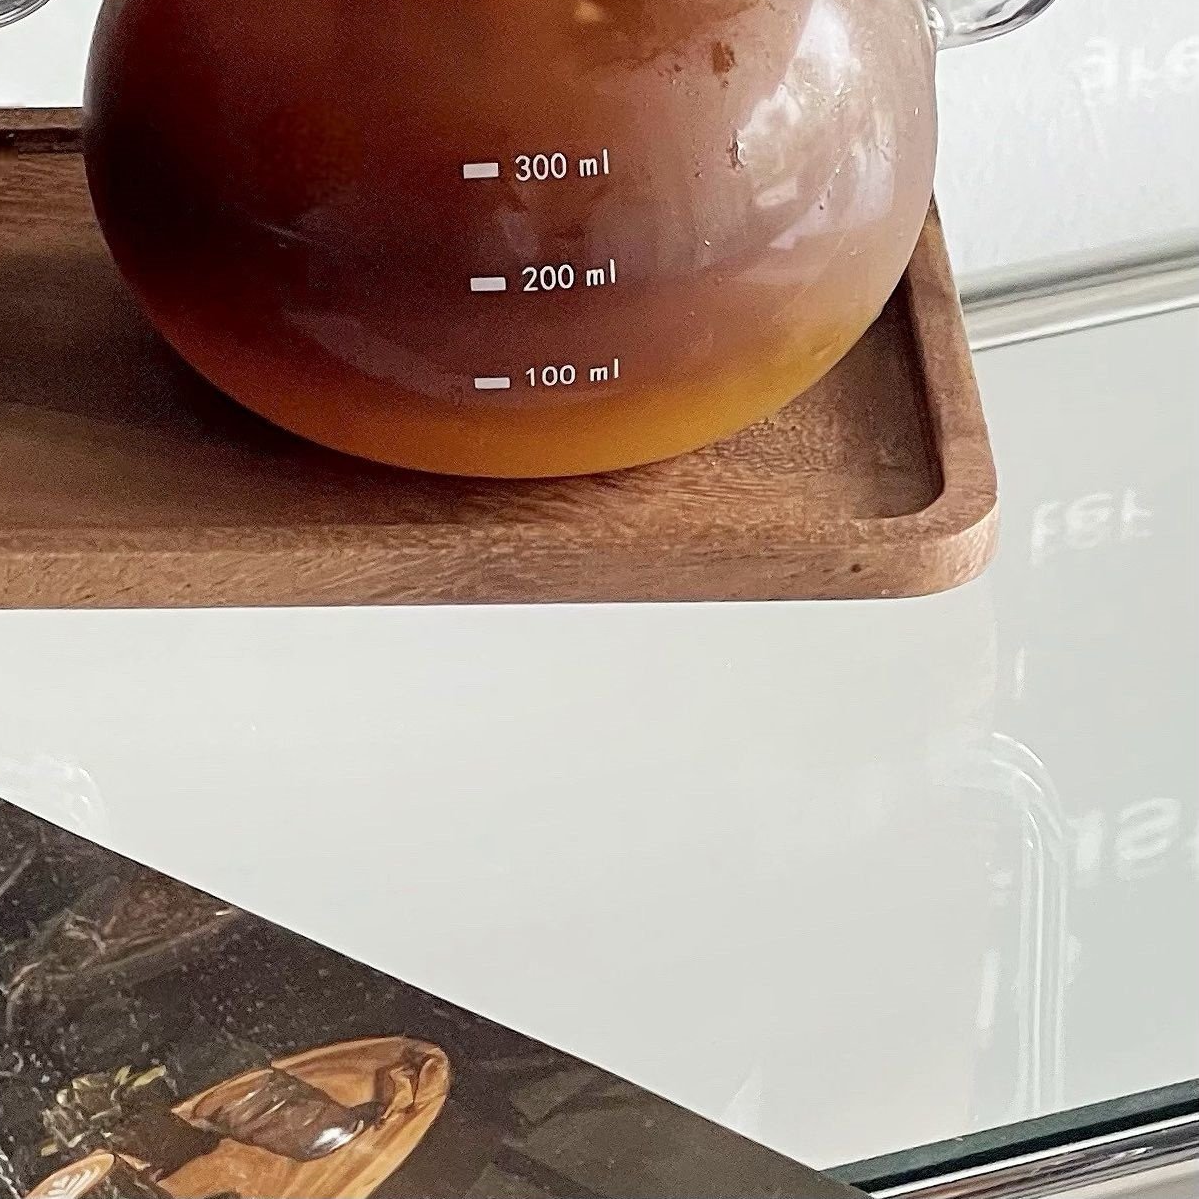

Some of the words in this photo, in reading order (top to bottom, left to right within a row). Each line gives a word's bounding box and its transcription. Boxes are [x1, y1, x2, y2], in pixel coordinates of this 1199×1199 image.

[515, 152, 567, 181] 300
[579, 148, 609, 177] ml
[521, 264, 574, 292] 200
[586, 258, 616, 287] ml
[525, 364, 576, 387] 100
[589, 358, 619, 382] ml
